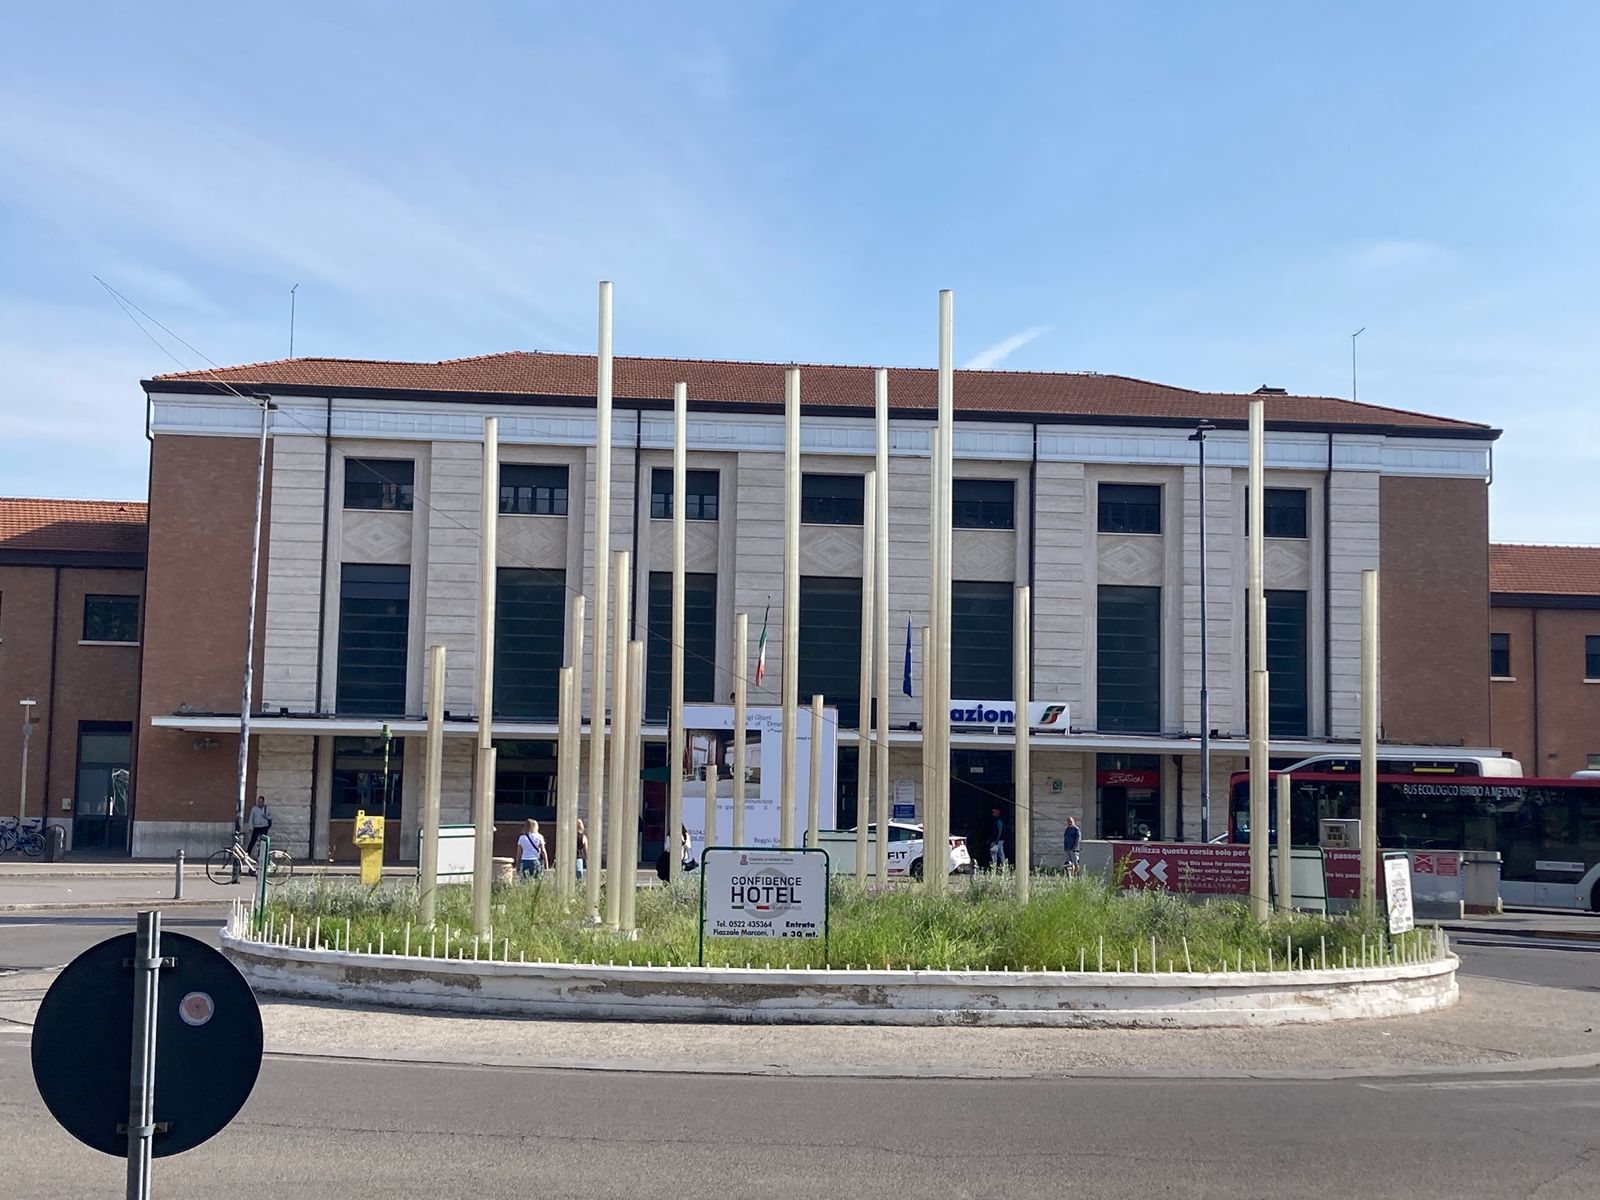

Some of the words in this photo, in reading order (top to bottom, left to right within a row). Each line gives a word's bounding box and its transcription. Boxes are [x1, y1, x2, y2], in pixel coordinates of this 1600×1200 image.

[950, 704, 1016, 723] azion
[1106, 773, 1144, 784] STATION
[1403, 784, 1417, 795] BUS
[1418, 784, 1459, 796] ECOLOGICO
[1484, 786, 1491, 797] A
[1491, 787, 1523, 798] METANO
[1131, 846, 1160, 854] Utilizza
[1162, 847, 1188, 855] questa
[1215, 848, 1231, 856] solo
[1334, 853, 1361, 861] passeg
[731, 876, 802, 886] CONFIDENCE
[731, 886, 802, 904] HOTEL
[713, 928, 740, 936] Piazzale
[741, 929, 769, 937] Marconi,
[771, 929, 775, 937] 1
